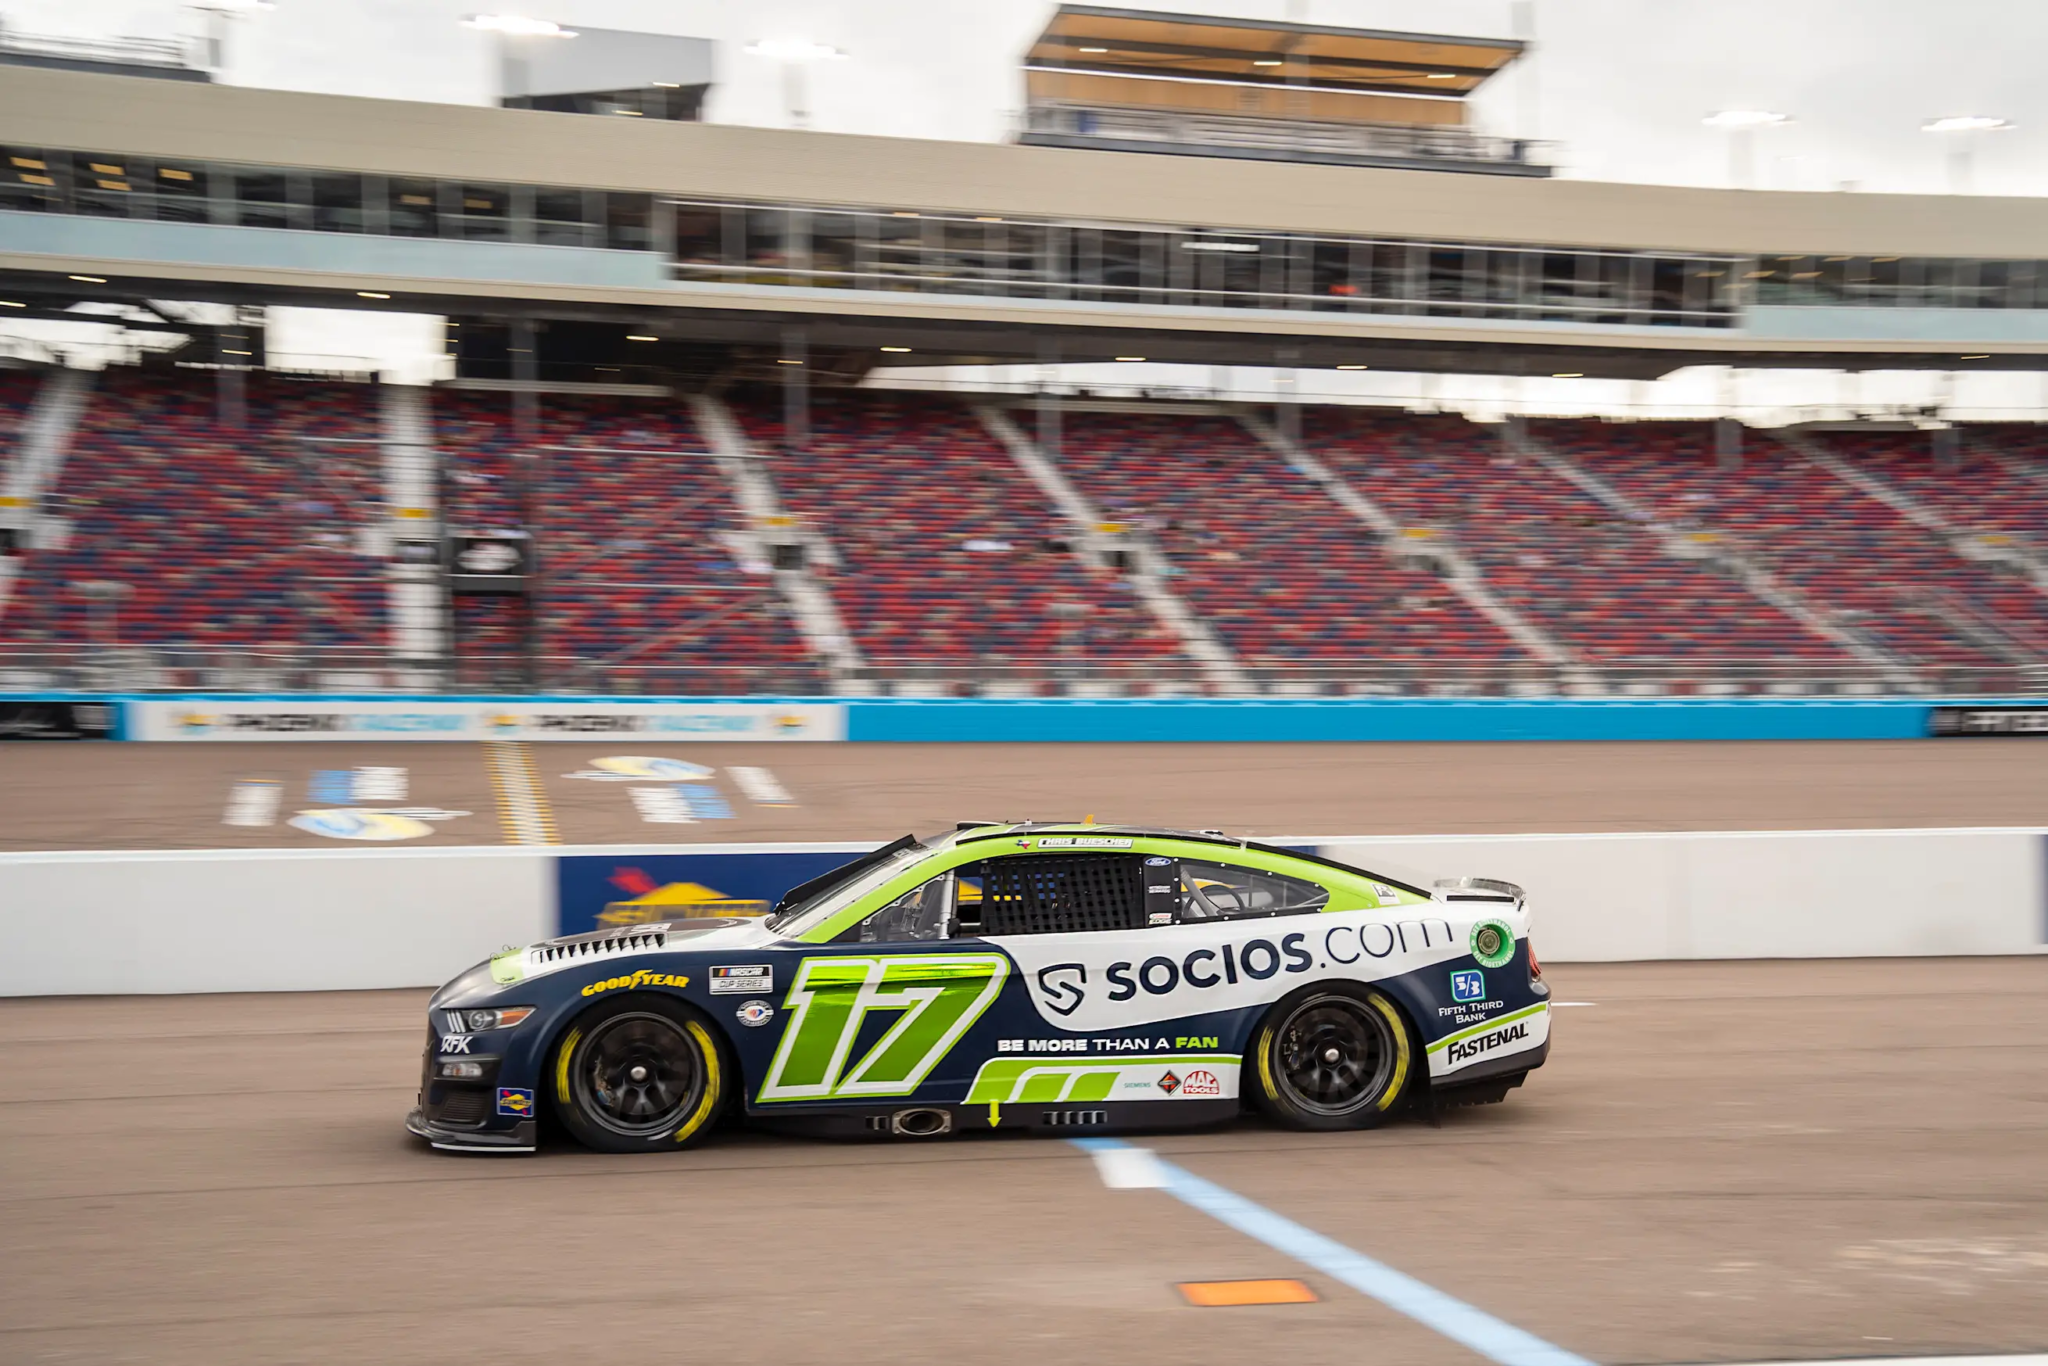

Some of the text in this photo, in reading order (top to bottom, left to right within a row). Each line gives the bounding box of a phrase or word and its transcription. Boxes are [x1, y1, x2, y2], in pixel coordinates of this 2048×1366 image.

[581, 969, 690, 997] GOODYEAR
[1438, 1000, 1504, 1016] FIFTH THIRD
[1455, 1012, 1487, 1024] BANK
[755, 953, 1011, 1103] 17
[440, 1035, 474, 1054] RFK
[997, 1037, 1218, 1051] BE MORE THAN A FAN
[1447, 1023, 1529, 1065] FASTENAL
